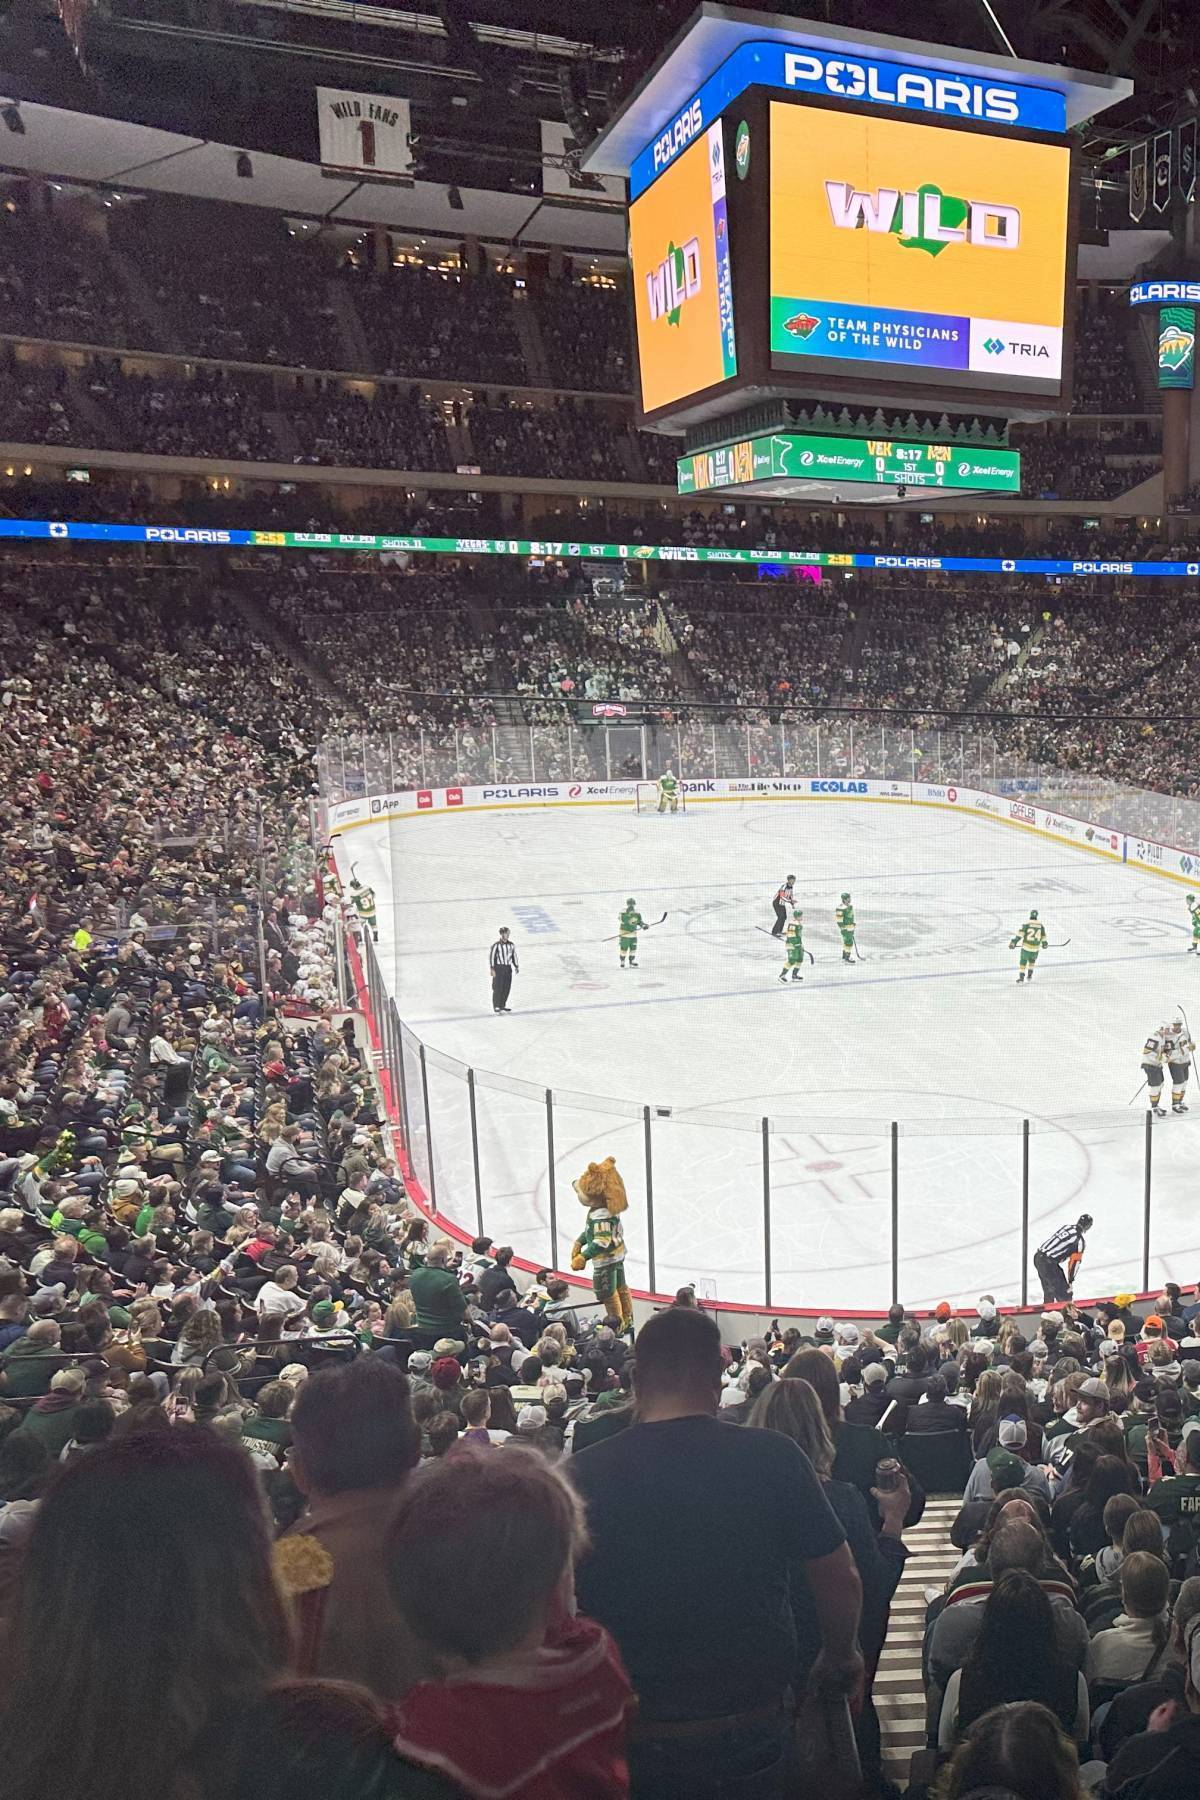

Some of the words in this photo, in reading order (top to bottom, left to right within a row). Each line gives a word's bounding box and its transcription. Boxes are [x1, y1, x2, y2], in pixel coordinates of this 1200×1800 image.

[784, 52, 1020, 122] POLARIS
[330, 101, 362, 119] WILD
[368, 103, 399, 128] FANS
[653, 98, 703, 172] POLARIS
[357, 120, 376, 166] 1
[825, 180, 1020, 249] WILD
[646, 237, 702, 320] WILD
[828, 317, 867, 332] TEAM
[872, 322, 959, 341] PHYSICIANS
[827, 331, 846, 343] OF
[852, 333, 880, 346] THE
[885, 337, 922, 350] WILD
[1009, 342, 1050, 358] TRIA
[896, 448, 922, 461] 8:17
[875, 457, 885, 472] 0
[903, 462, 917, 471] 1ST
[935, 461, 945, 476] 0
[894, 473, 926, 485] SHOTS
[145, 528, 231, 543] POLARIS
[382, 539, 410, 548] SHOTS
[458, 539, 488, 549] VEGAS
[509, 540, 519, 554] 0
[530, 542, 563, 555] 8:17
[589, 545, 606, 556] 1ST
[618, 544, 628, 558] 0
[659, 549, 699, 561] WILD
[707, 551, 733, 560] SHOTS
[874, 557, 942, 569] POLARIS
[1072, 562, 1133, 574] POLARIS
[483, 787, 559, 800] POLARIS
[811, 780, 868, 793] ECOLAB
[1009, 803, 1036, 820] LOFFLER
